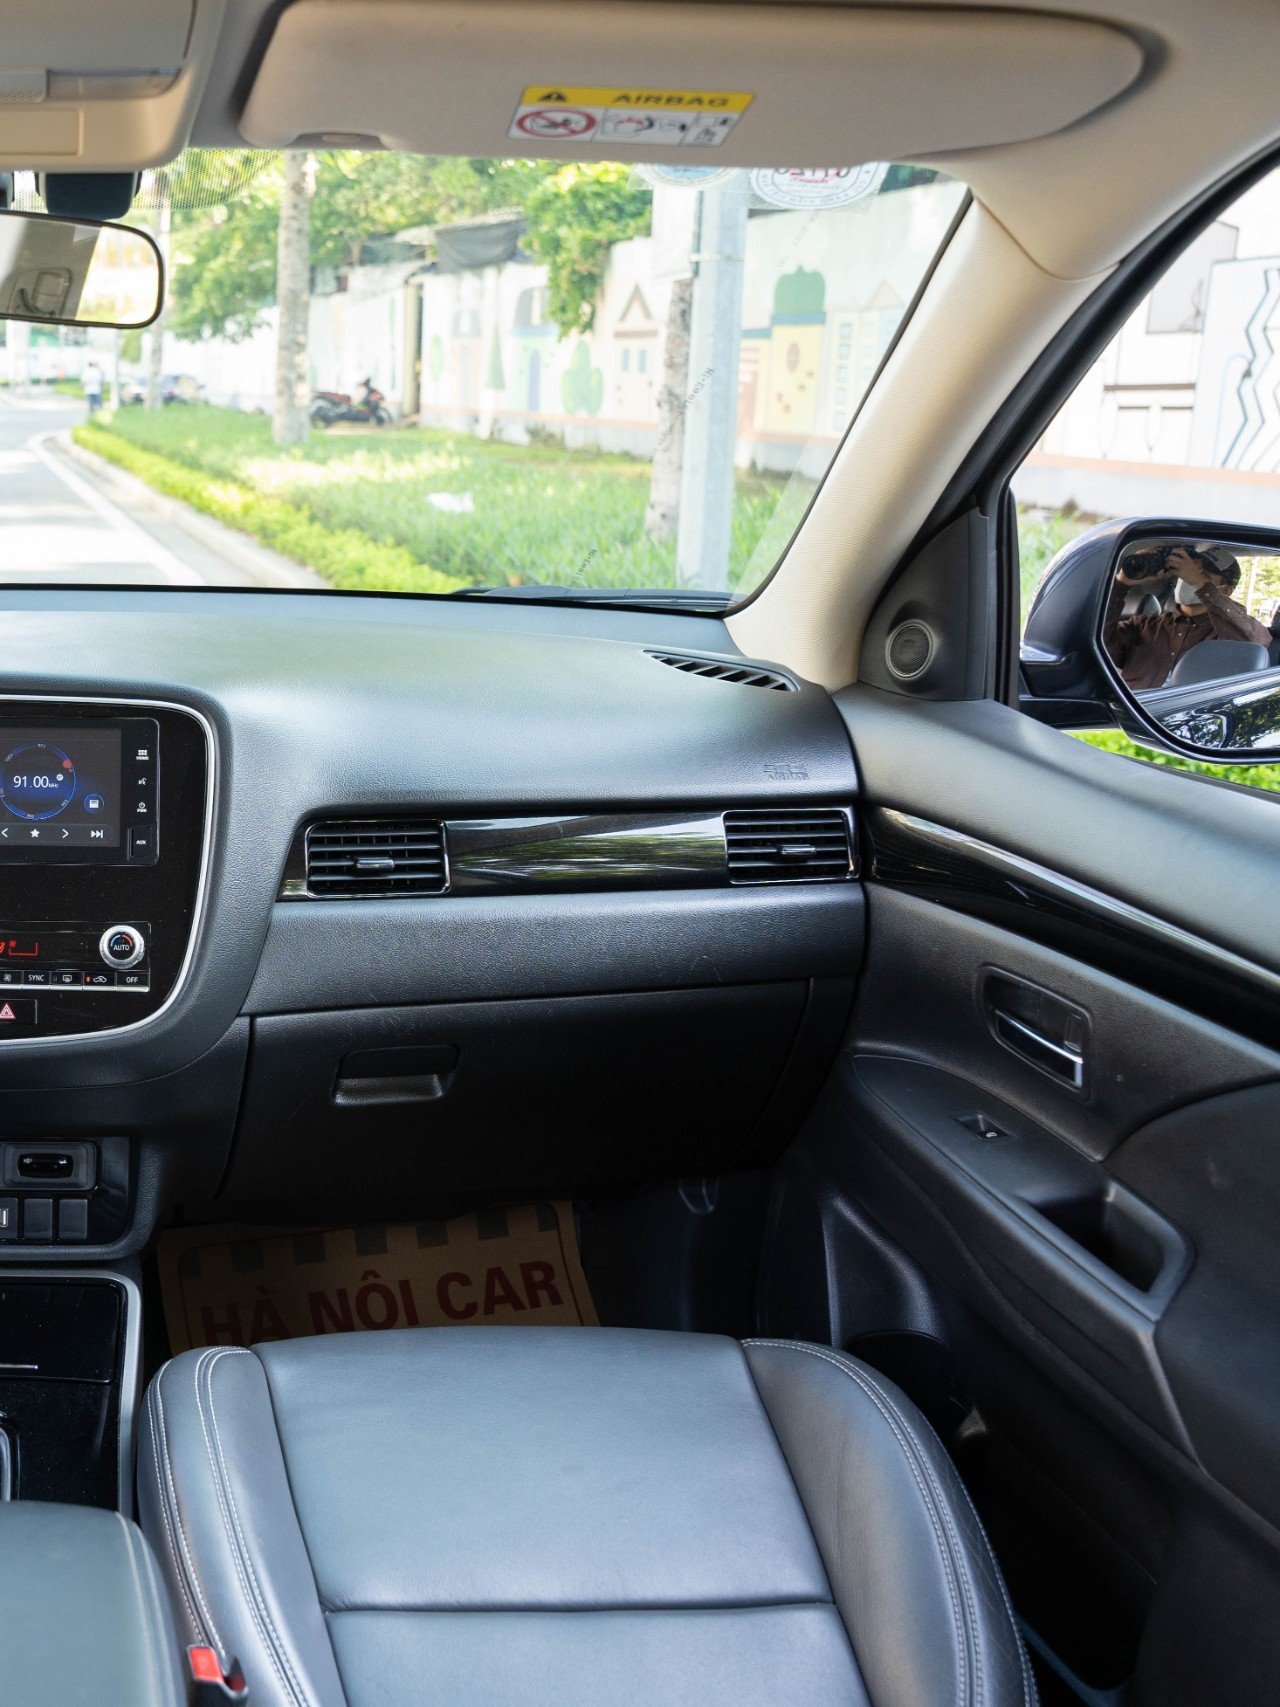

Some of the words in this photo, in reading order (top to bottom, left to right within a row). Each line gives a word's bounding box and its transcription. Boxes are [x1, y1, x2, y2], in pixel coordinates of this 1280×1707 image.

[613, 94, 728, 107] AIRBAG
[13, 775, 49, 788] 91.00
[28, 974, 45, 982] SYNC
[125, 976, 138, 984] OFF
[200, 1285, 293, 1347] HÀ
[436, 1259, 564, 1321] CAR
